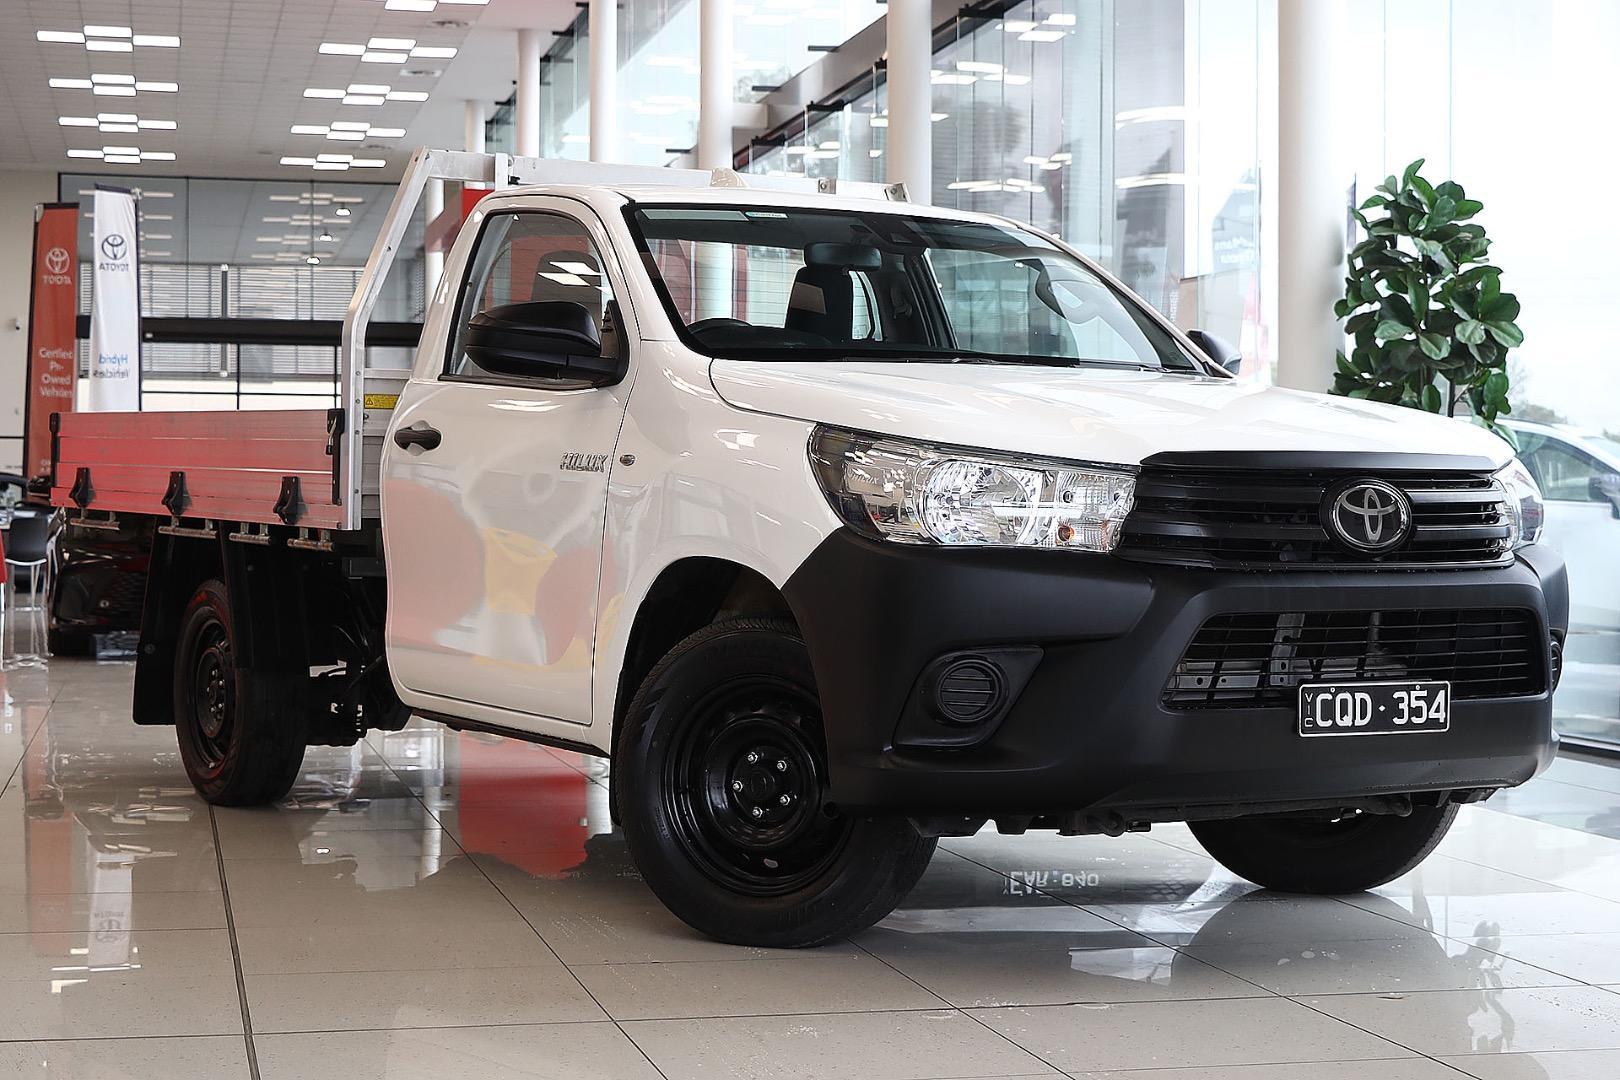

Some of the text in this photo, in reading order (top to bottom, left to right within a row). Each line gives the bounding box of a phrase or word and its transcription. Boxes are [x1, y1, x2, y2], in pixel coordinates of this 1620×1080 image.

[1304, 692, 1314, 728] VIC
[1315, 690, 1446, 727] CQD 354
